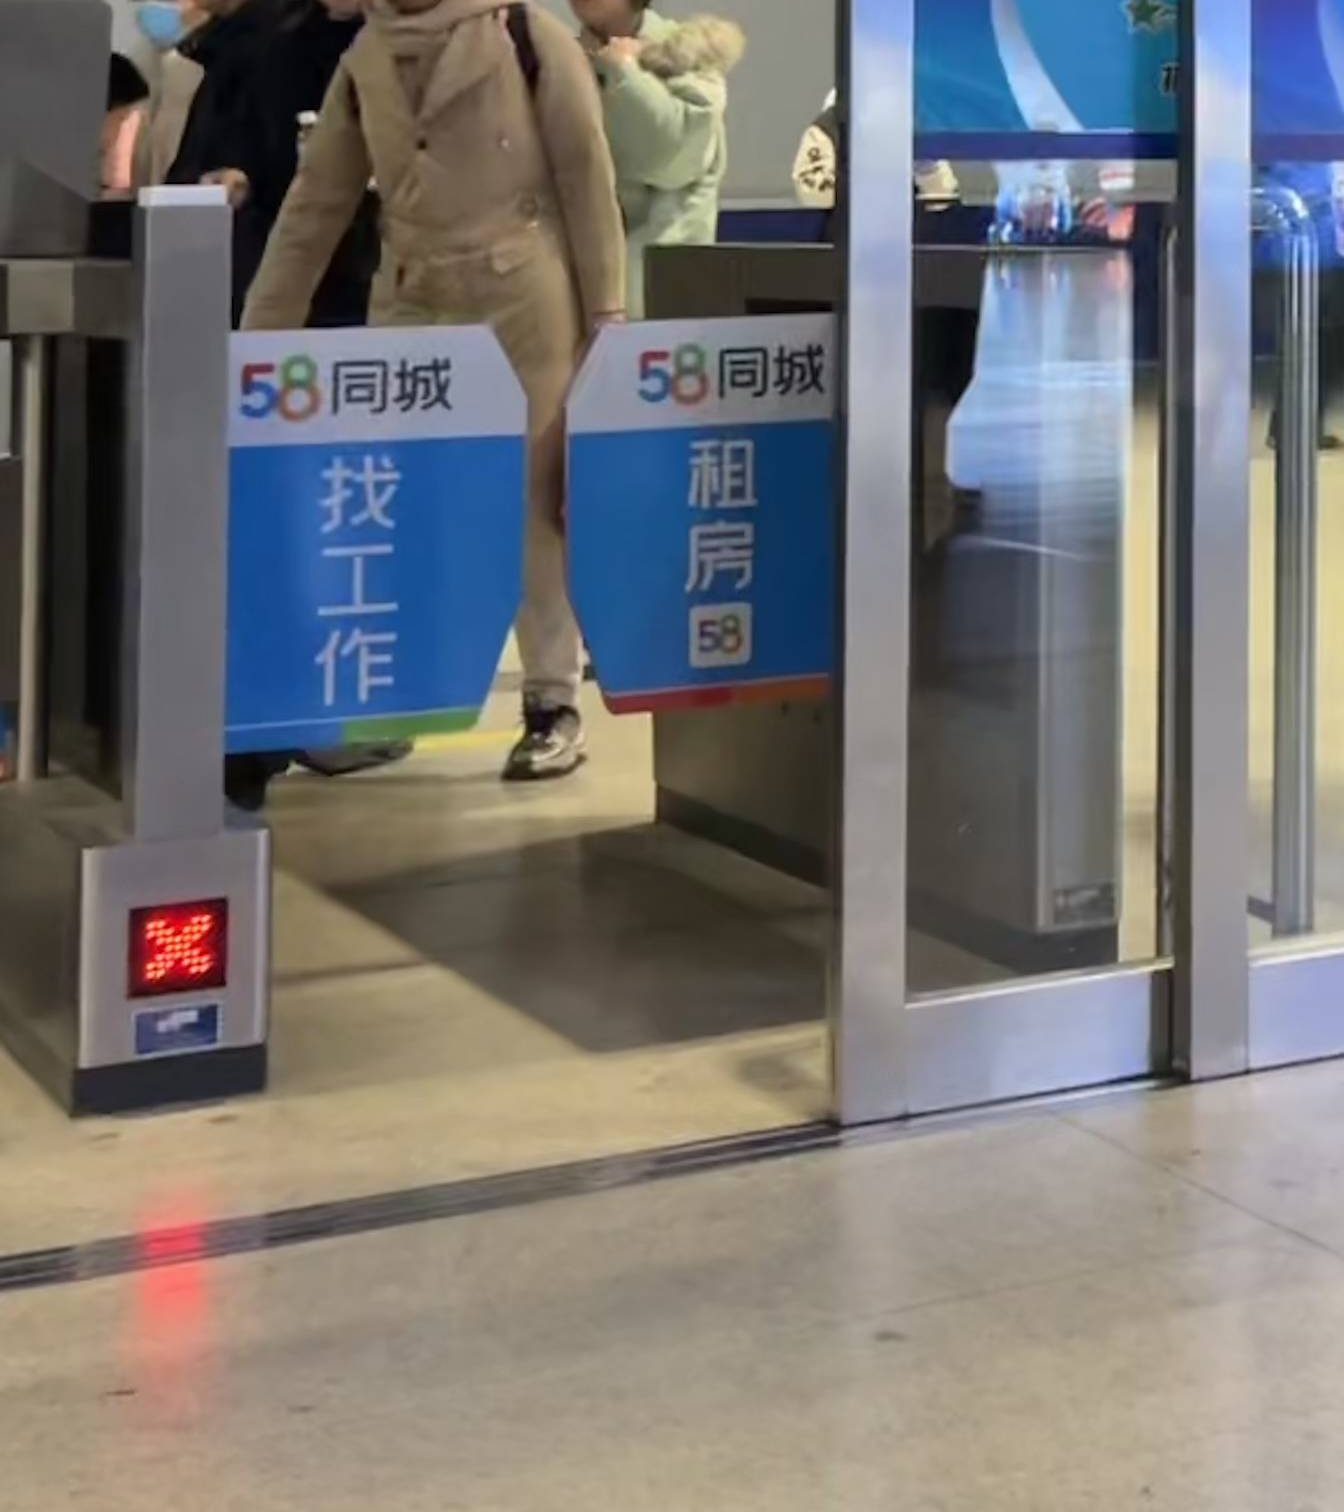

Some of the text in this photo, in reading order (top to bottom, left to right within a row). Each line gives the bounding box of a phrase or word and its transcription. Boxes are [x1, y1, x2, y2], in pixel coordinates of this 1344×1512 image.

[240, 354, 454, 422] 58同城
[637, 342, 827, 405] 58同城
[684, 438, 759, 593] 租房
[315, 455, 402, 707] 找工作
[697, 613, 745, 654] 58
